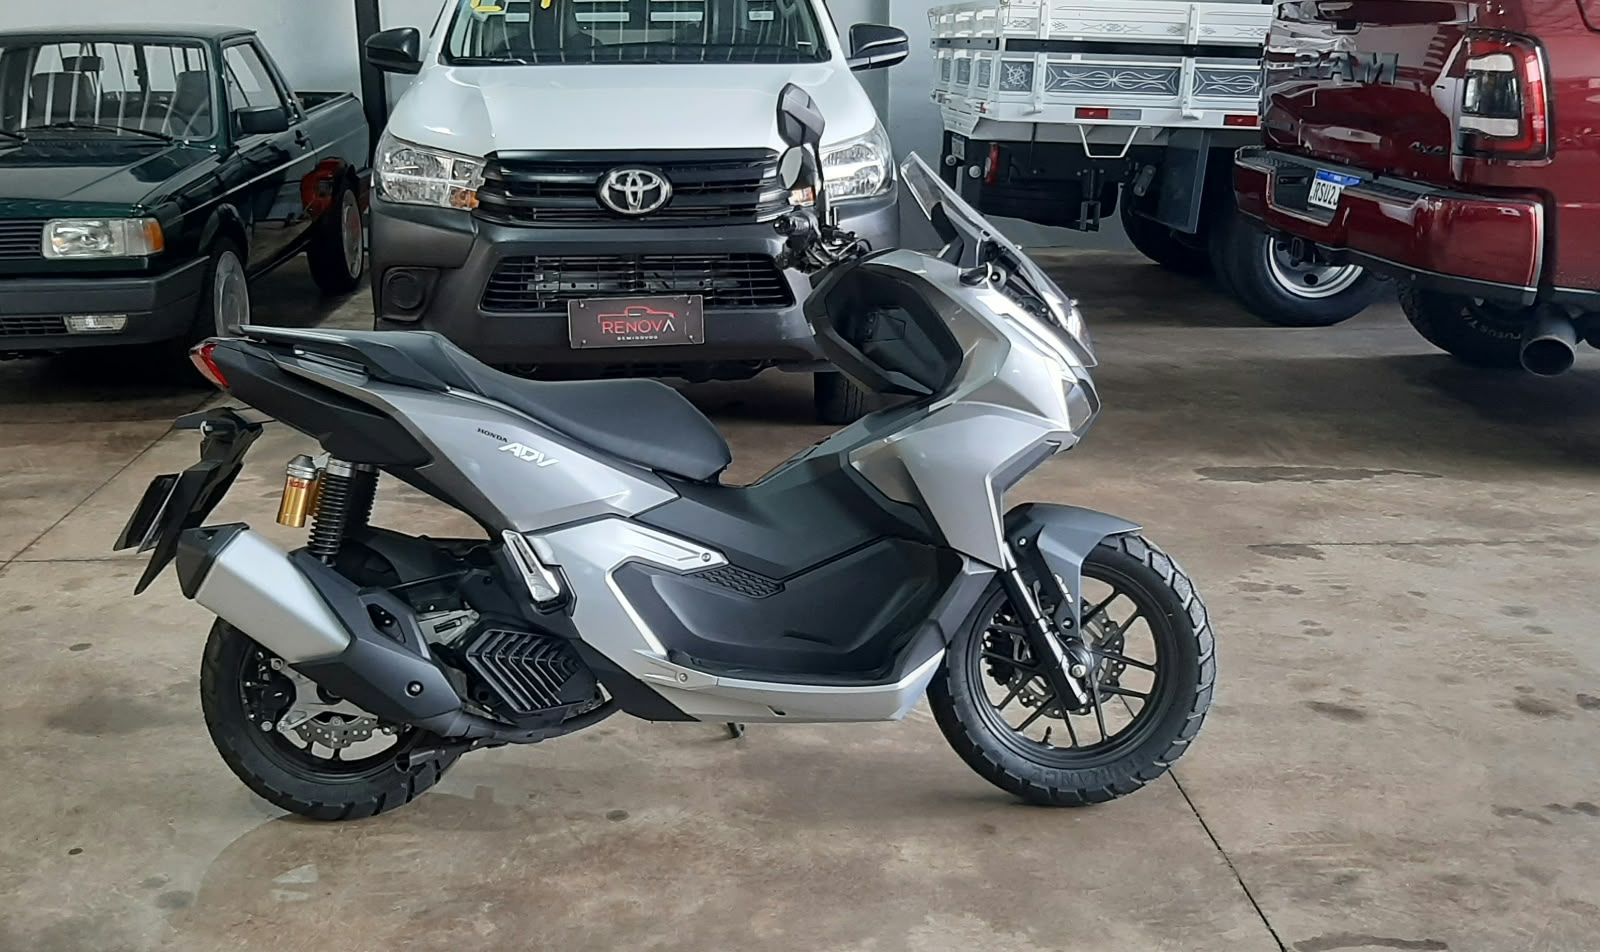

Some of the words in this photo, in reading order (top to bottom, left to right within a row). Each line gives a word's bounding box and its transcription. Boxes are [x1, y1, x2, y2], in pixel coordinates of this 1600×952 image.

[1295, 48, 1399, 85] RAM
[602, 319, 675, 334] RENOVA
[477, 427, 508, 443] HONDA
[498, 443, 560, 467] ADV
